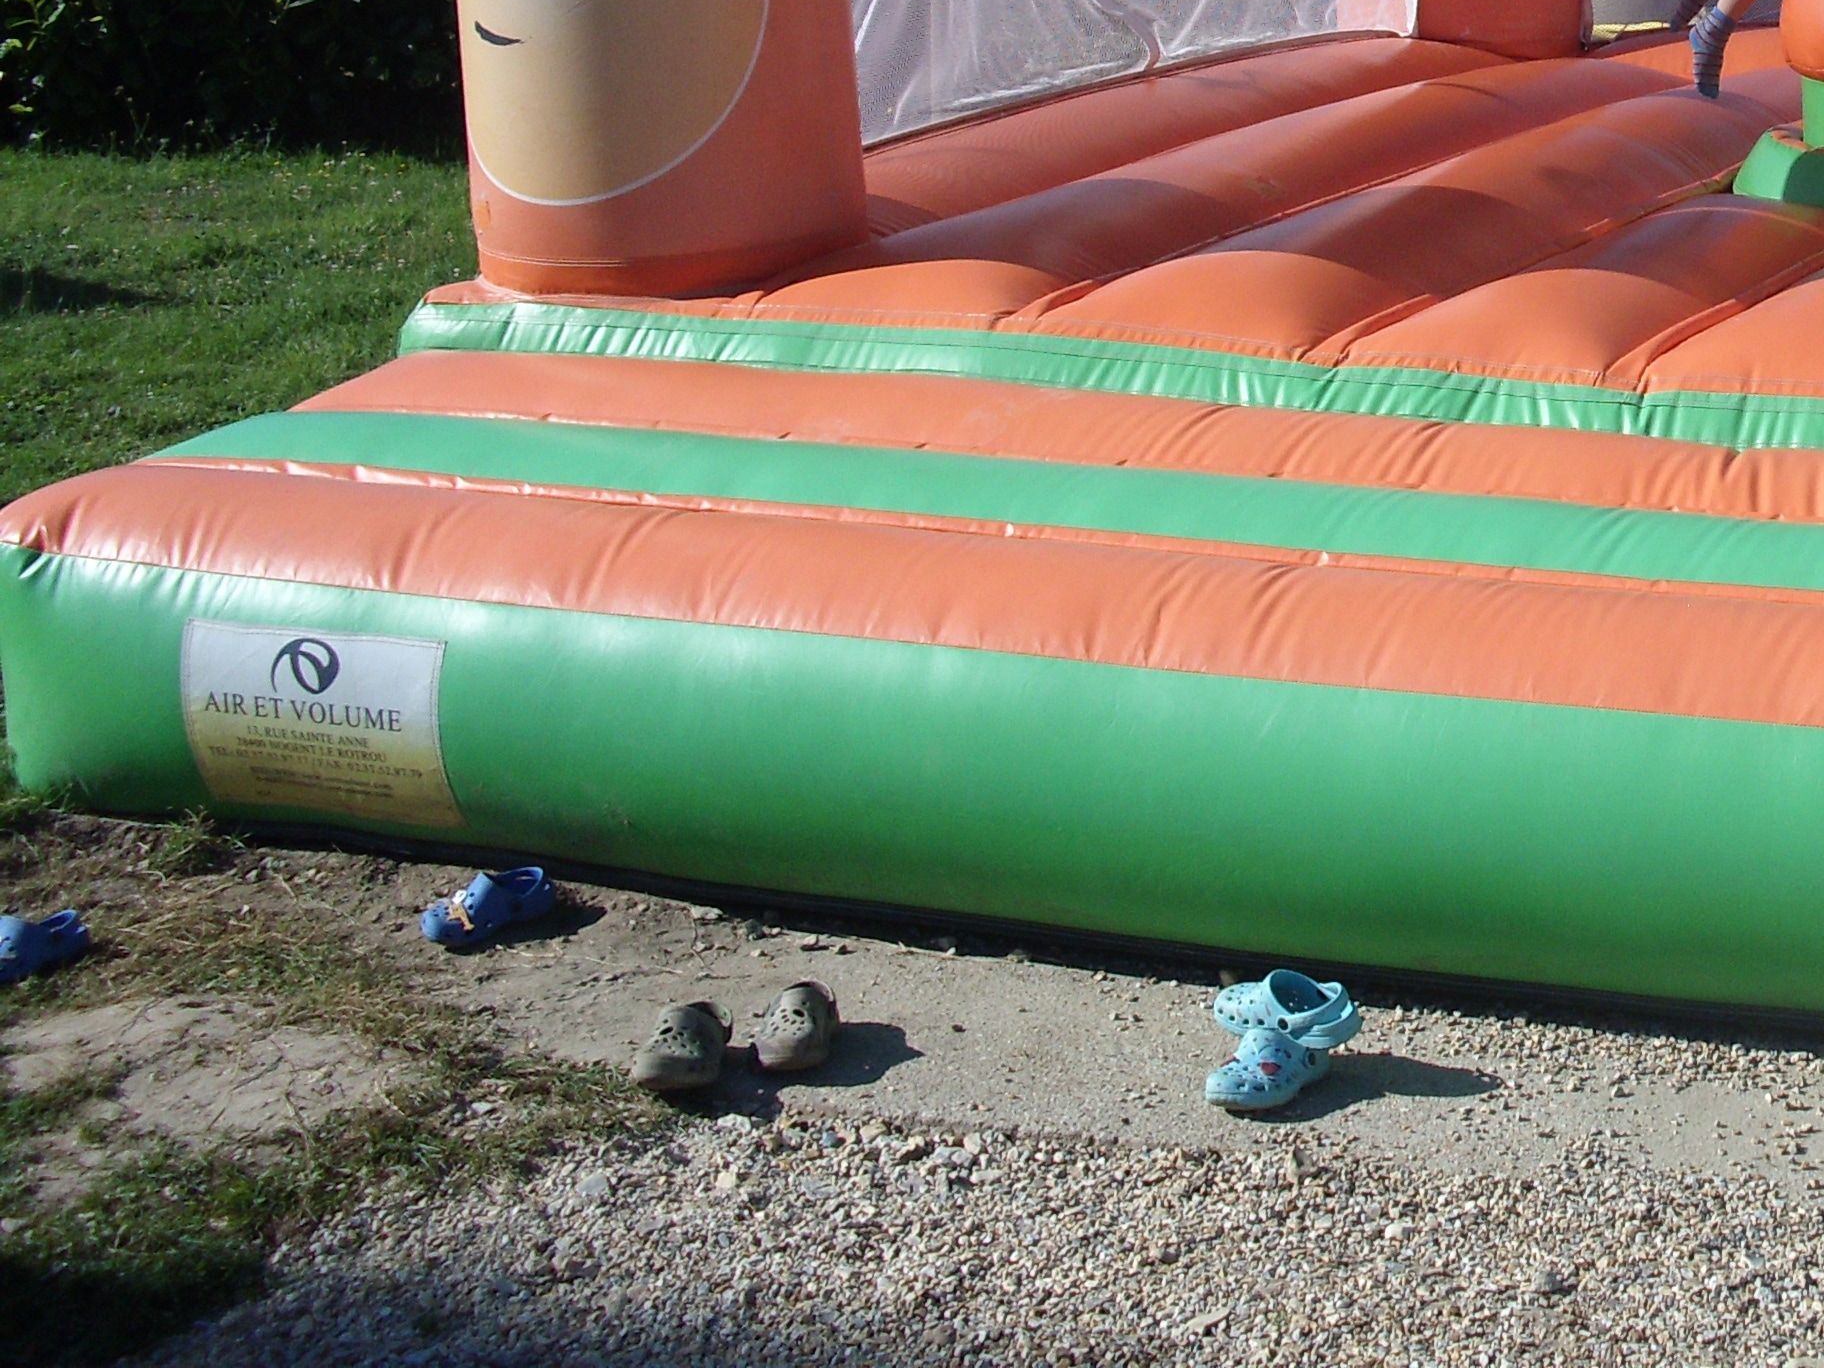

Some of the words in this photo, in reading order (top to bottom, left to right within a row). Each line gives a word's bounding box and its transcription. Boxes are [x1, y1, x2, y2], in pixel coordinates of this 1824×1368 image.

[204, 691, 247, 715] AIR
[254, 696, 283, 719] ET
[290, 699, 402, 732] VOLUME
[265, 726, 289, 738] RUE
[291, 730, 334, 744] SAINTE
[338, 736, 370, 748] ANNE
[337, 748, 388, 763] ROTROU
